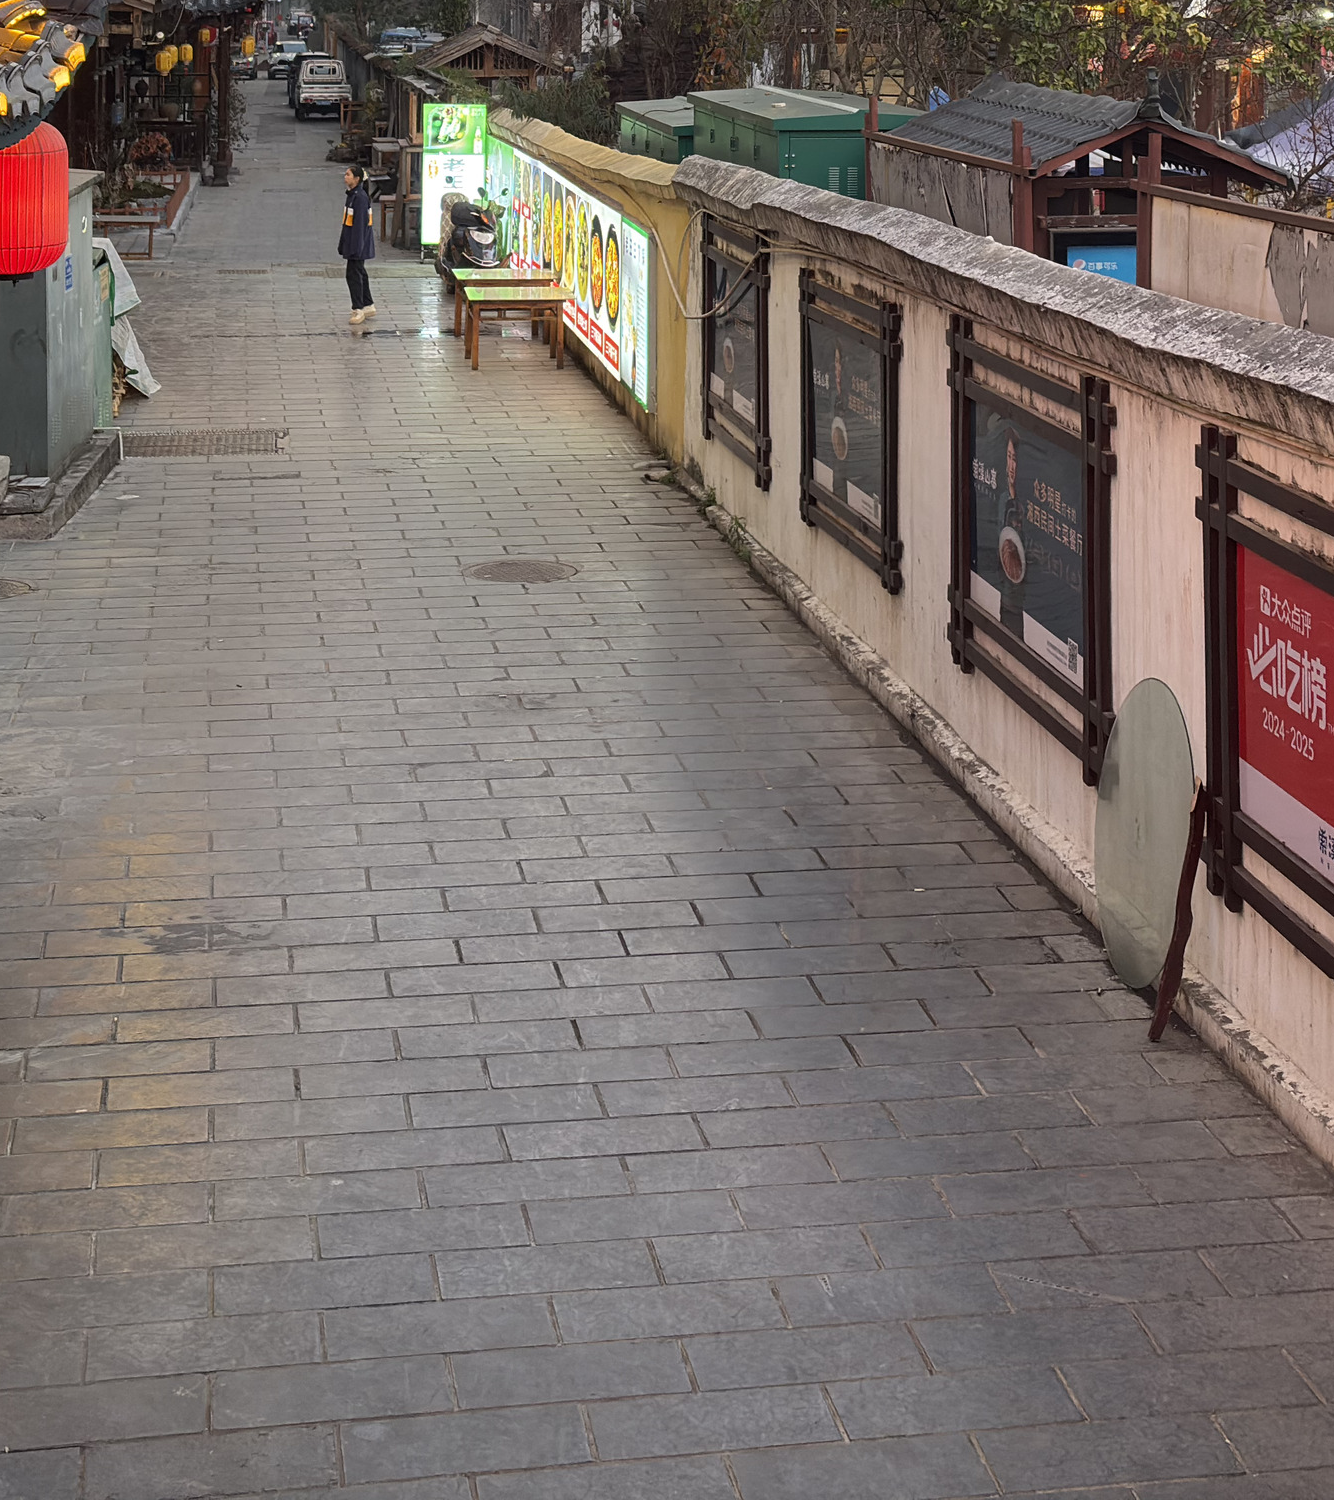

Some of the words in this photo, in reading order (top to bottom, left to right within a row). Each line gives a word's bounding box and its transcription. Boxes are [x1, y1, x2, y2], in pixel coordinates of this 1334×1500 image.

[1271, 592, 1312, 639] 大众点评
[1246, 622, 1327, 731] 必吃榜
[1262, 707, 1315, 762] 2024-2025
